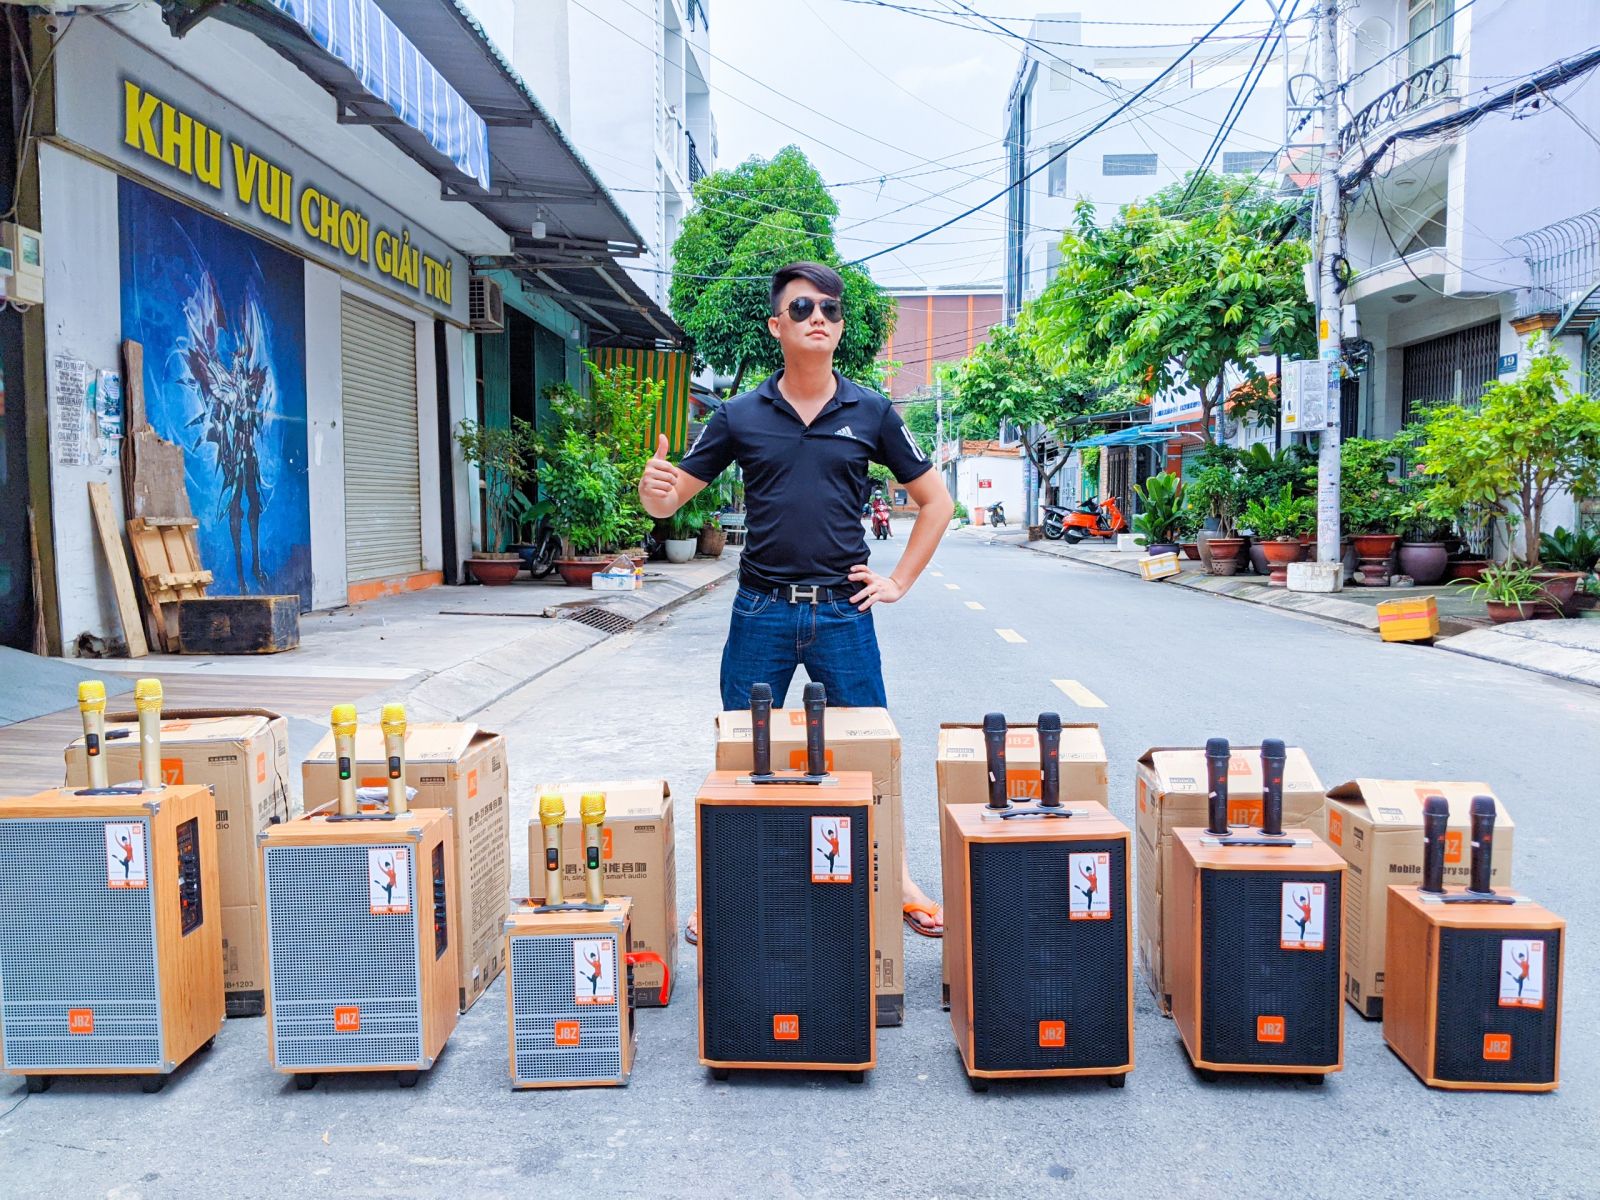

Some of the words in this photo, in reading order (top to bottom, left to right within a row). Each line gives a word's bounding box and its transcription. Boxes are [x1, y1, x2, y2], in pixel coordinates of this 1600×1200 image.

[124, 79, 222, 190] KHU
[230, 141, 293, 225] VUI
[300, 187, 369, 264] CHƠI
[375, 230, 419, 289] GIẢI
[423, 256, 452, 305] TRÍ
[1503, 355, 1515, 366] 19
[1389, 864, 1421, 874] Mobile
[71, 1015, 91, 1027] JBZ
[337, 1012, 358, 1025] JBZ
[557, 1027, 578, 1039] JBZ
[776, 1021, 796, 1034] JBZ
[1042, 1027, 1062, 1040] JBZ
[1260, 1023, 1281, 1035] JBZ
[1487, 1041, 1508, 1053] JBZ
